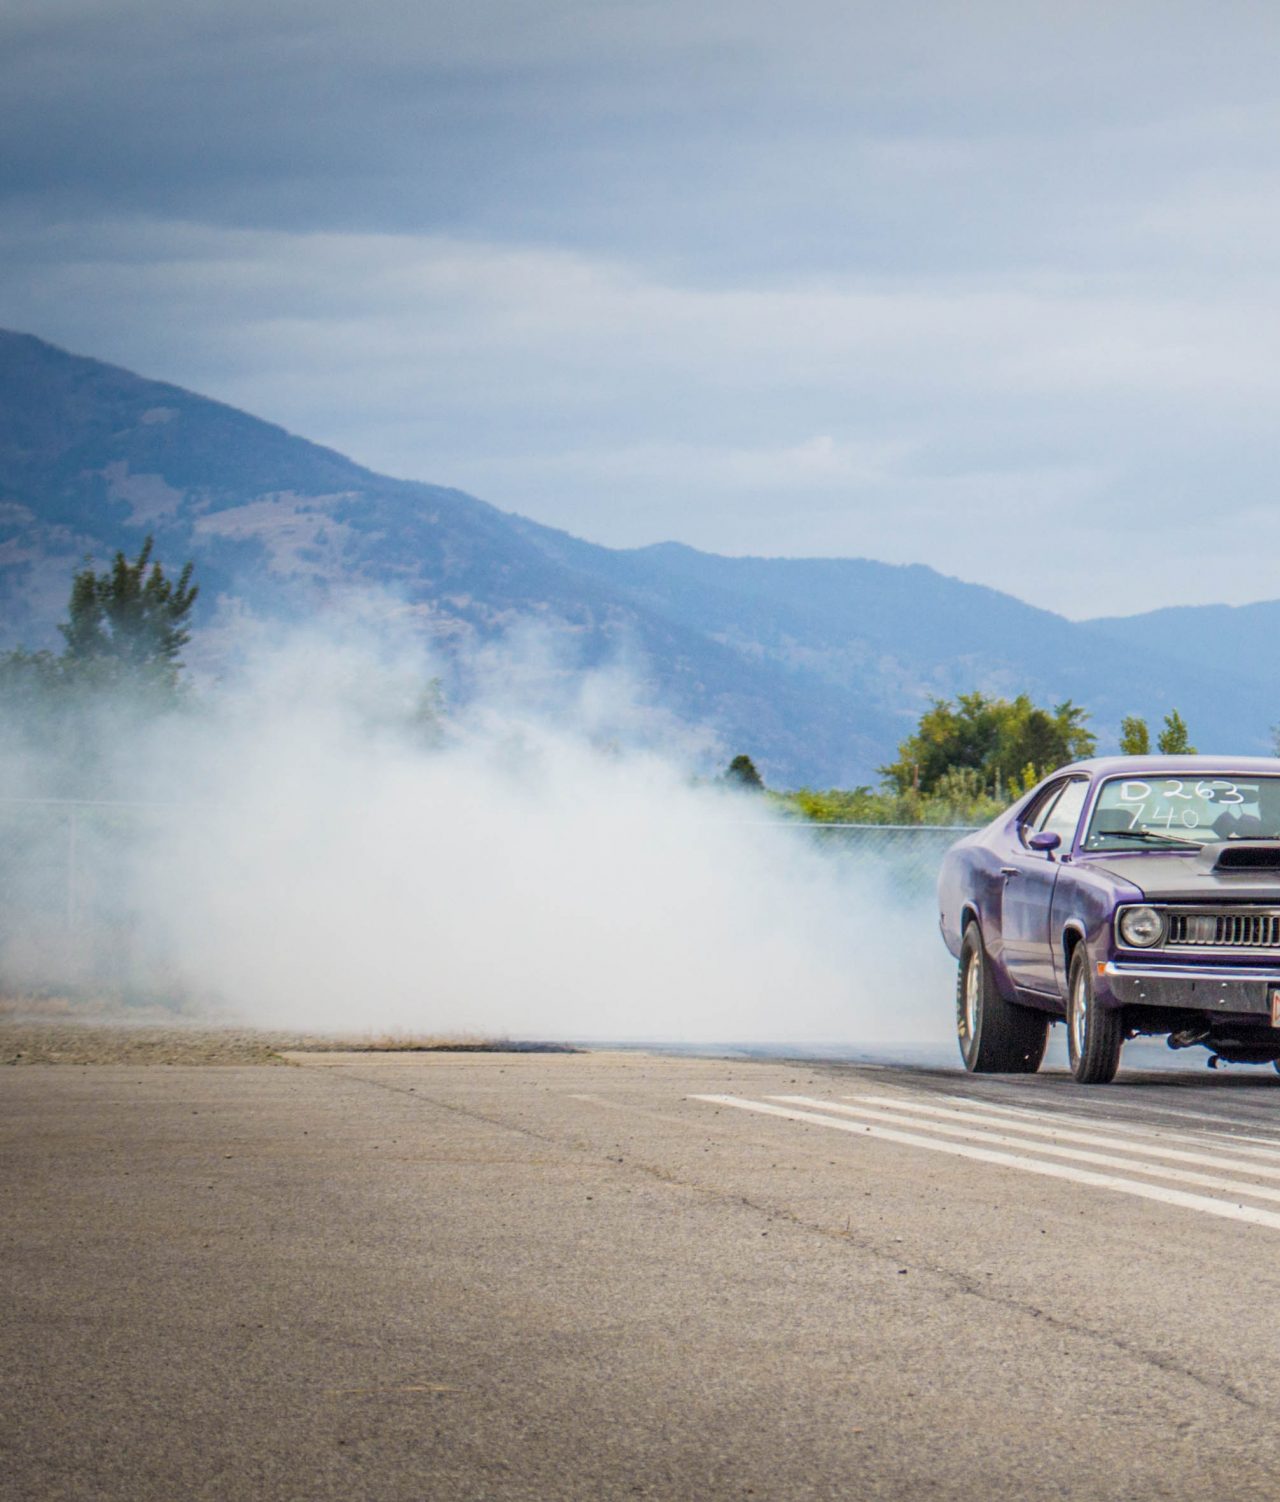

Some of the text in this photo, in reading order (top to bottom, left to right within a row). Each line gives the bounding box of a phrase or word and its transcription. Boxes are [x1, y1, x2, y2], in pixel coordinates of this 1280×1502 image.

[1121, 779, 1244, 804] D 263
[1115, 802, 1199, 830] 7.40
